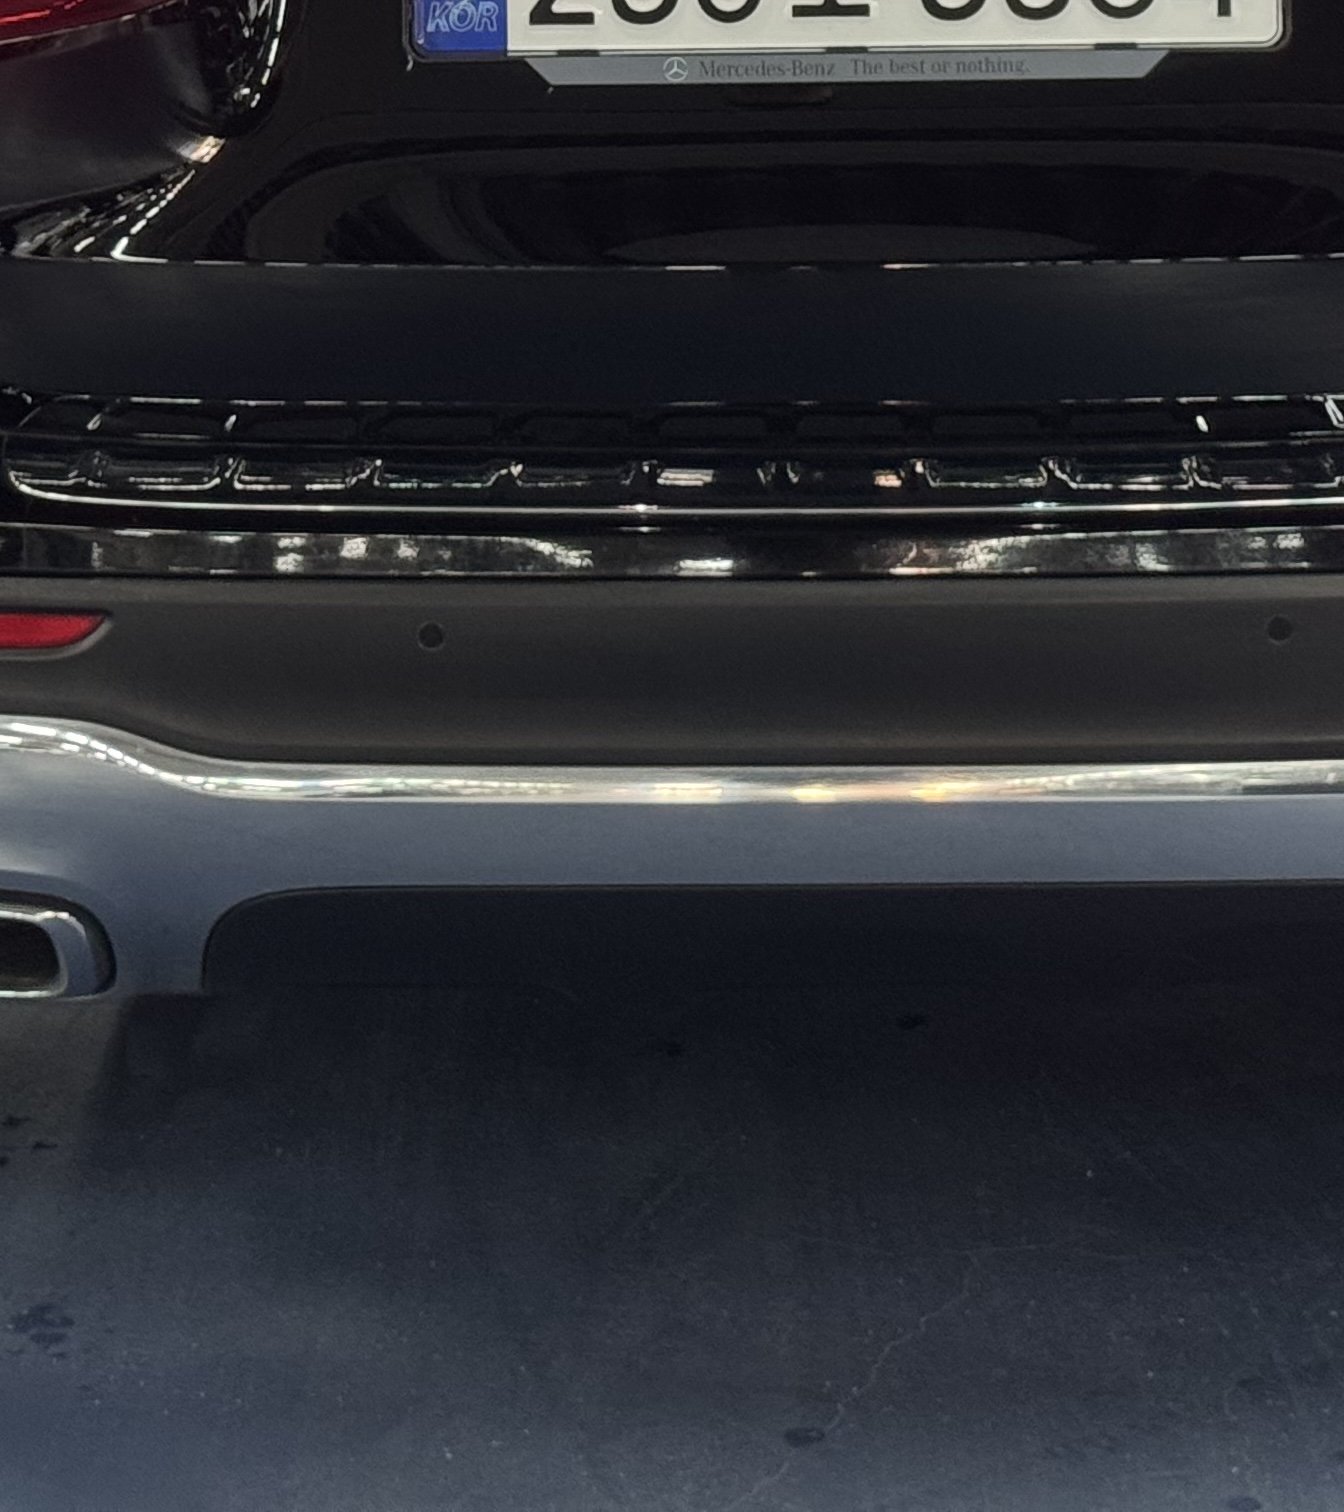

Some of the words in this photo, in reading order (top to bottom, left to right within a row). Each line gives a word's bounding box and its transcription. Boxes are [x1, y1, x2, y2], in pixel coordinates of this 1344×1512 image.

[426, 0, 500, 33] KOR
[698, 60, 836, 79] Mercedes-Benz
[850, 56, 884, 76] The
[889, 56, 926, 75] best
[931, 61, 951, 75] or
[955, 55, 1032, 78] nothing.
